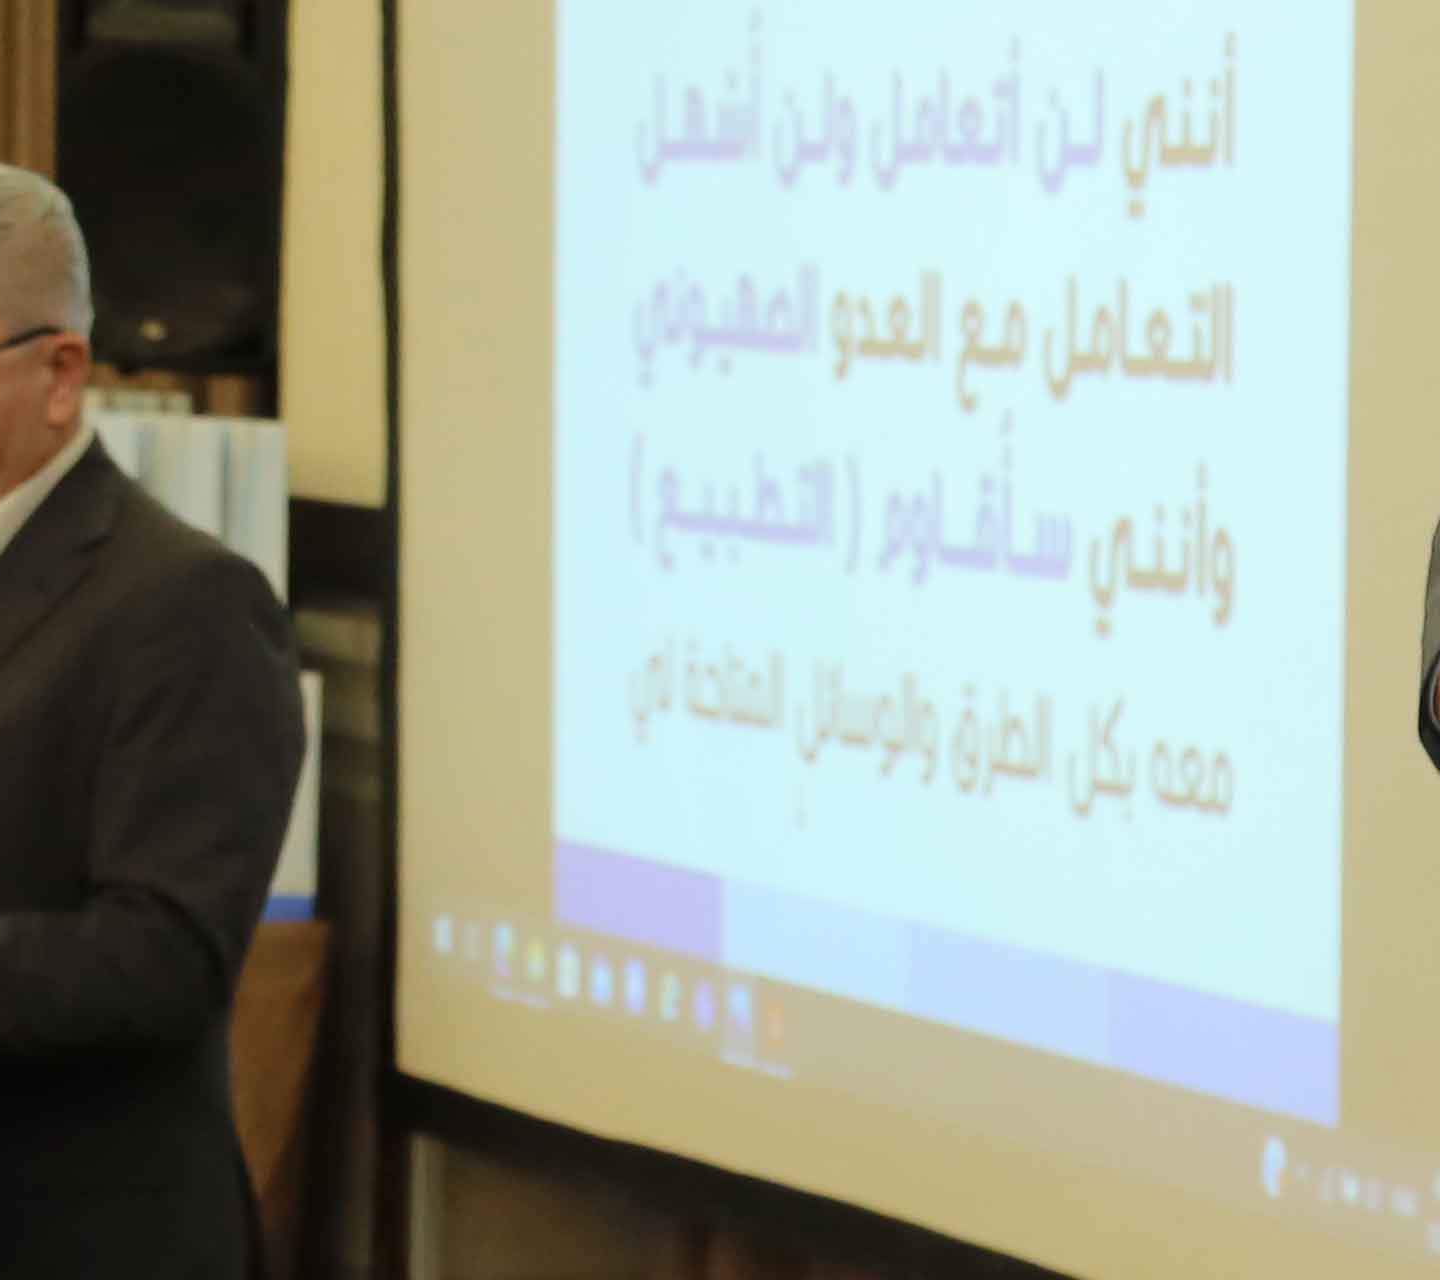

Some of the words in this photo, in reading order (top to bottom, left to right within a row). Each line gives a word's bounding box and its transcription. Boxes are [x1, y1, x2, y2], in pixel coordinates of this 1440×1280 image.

[830, 267, 941, 382] العدو
[956, 297, 1026, 414] مع
[1043, 276, 1236, 403] التعامل
